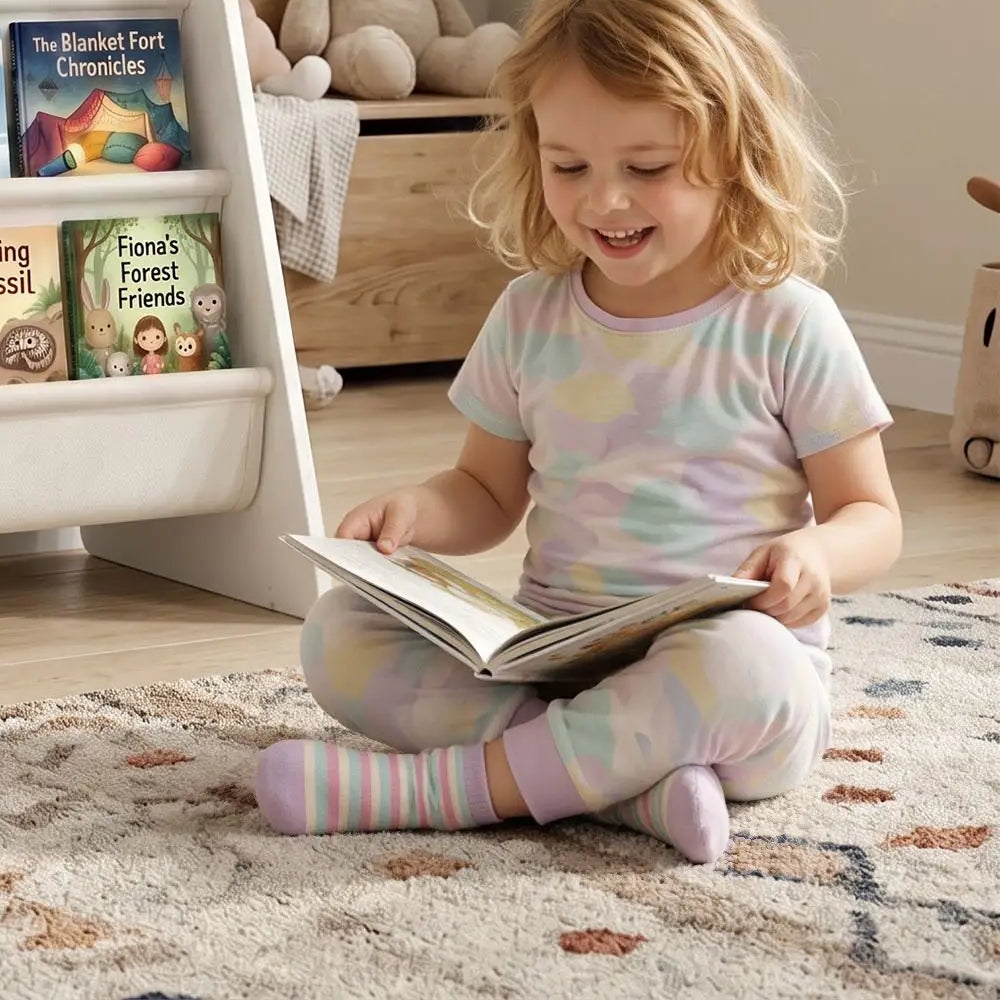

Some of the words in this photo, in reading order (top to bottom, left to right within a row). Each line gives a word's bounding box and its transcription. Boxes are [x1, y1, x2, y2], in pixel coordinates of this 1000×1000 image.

[32, 37, 57, 52] The
[61, 32, 123, 52] Blanket
[129, 31, 165, 50] Fort
[57, 54, 146, 77] Chronicles
[118, 234, 179, 257] Fiona's
[121, 261, 179, 283] Forest
[119, 286, 185, 309] Friends
